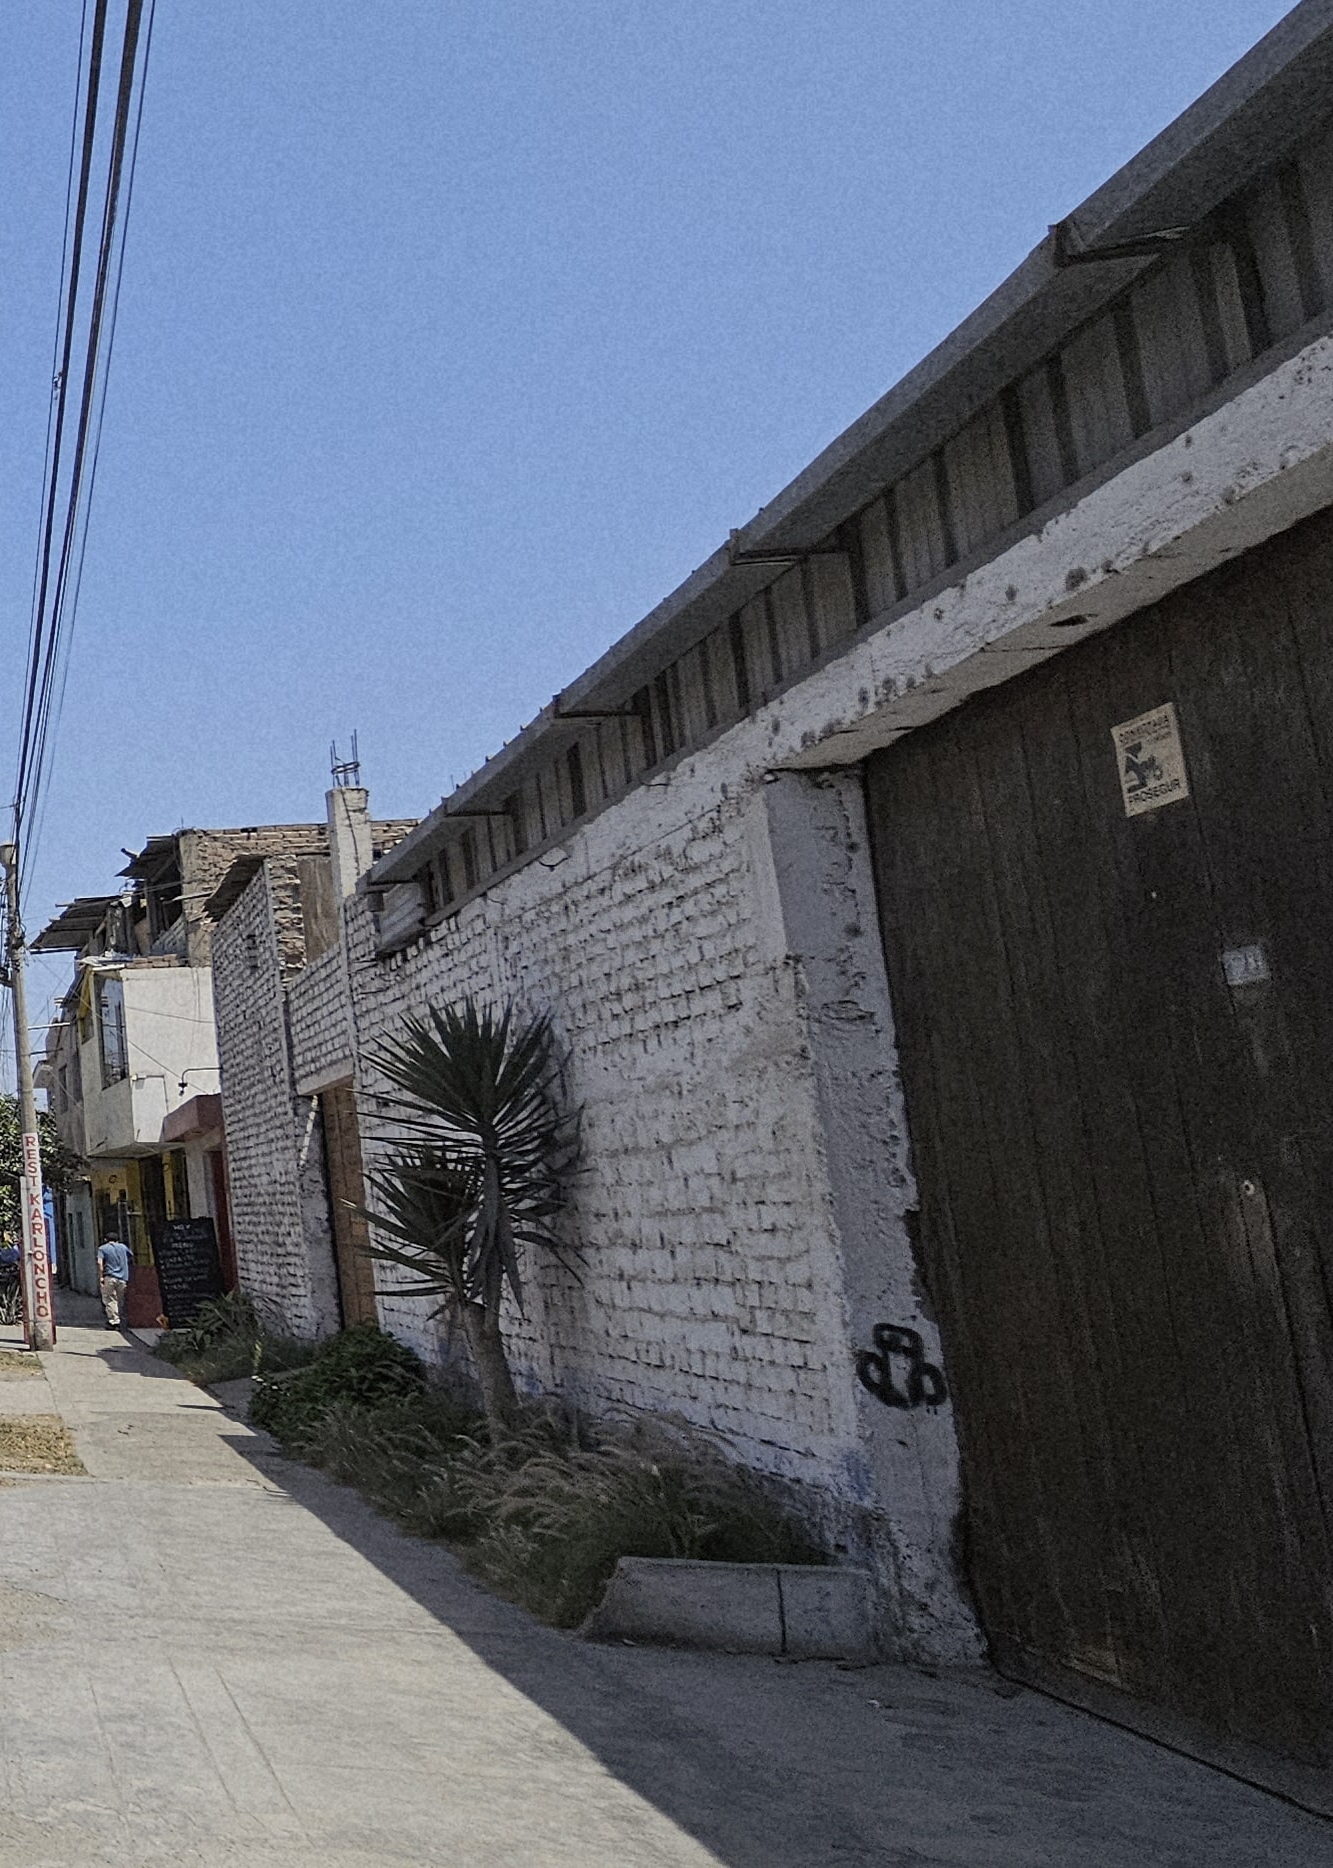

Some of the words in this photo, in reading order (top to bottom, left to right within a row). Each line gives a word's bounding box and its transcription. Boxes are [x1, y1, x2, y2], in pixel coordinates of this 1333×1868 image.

[1128, 778, 1181, 803] PROSEGUR
[25, 1135, 38, 1187] REST
[30, 1193, 49, 1318] KARLONCHO
